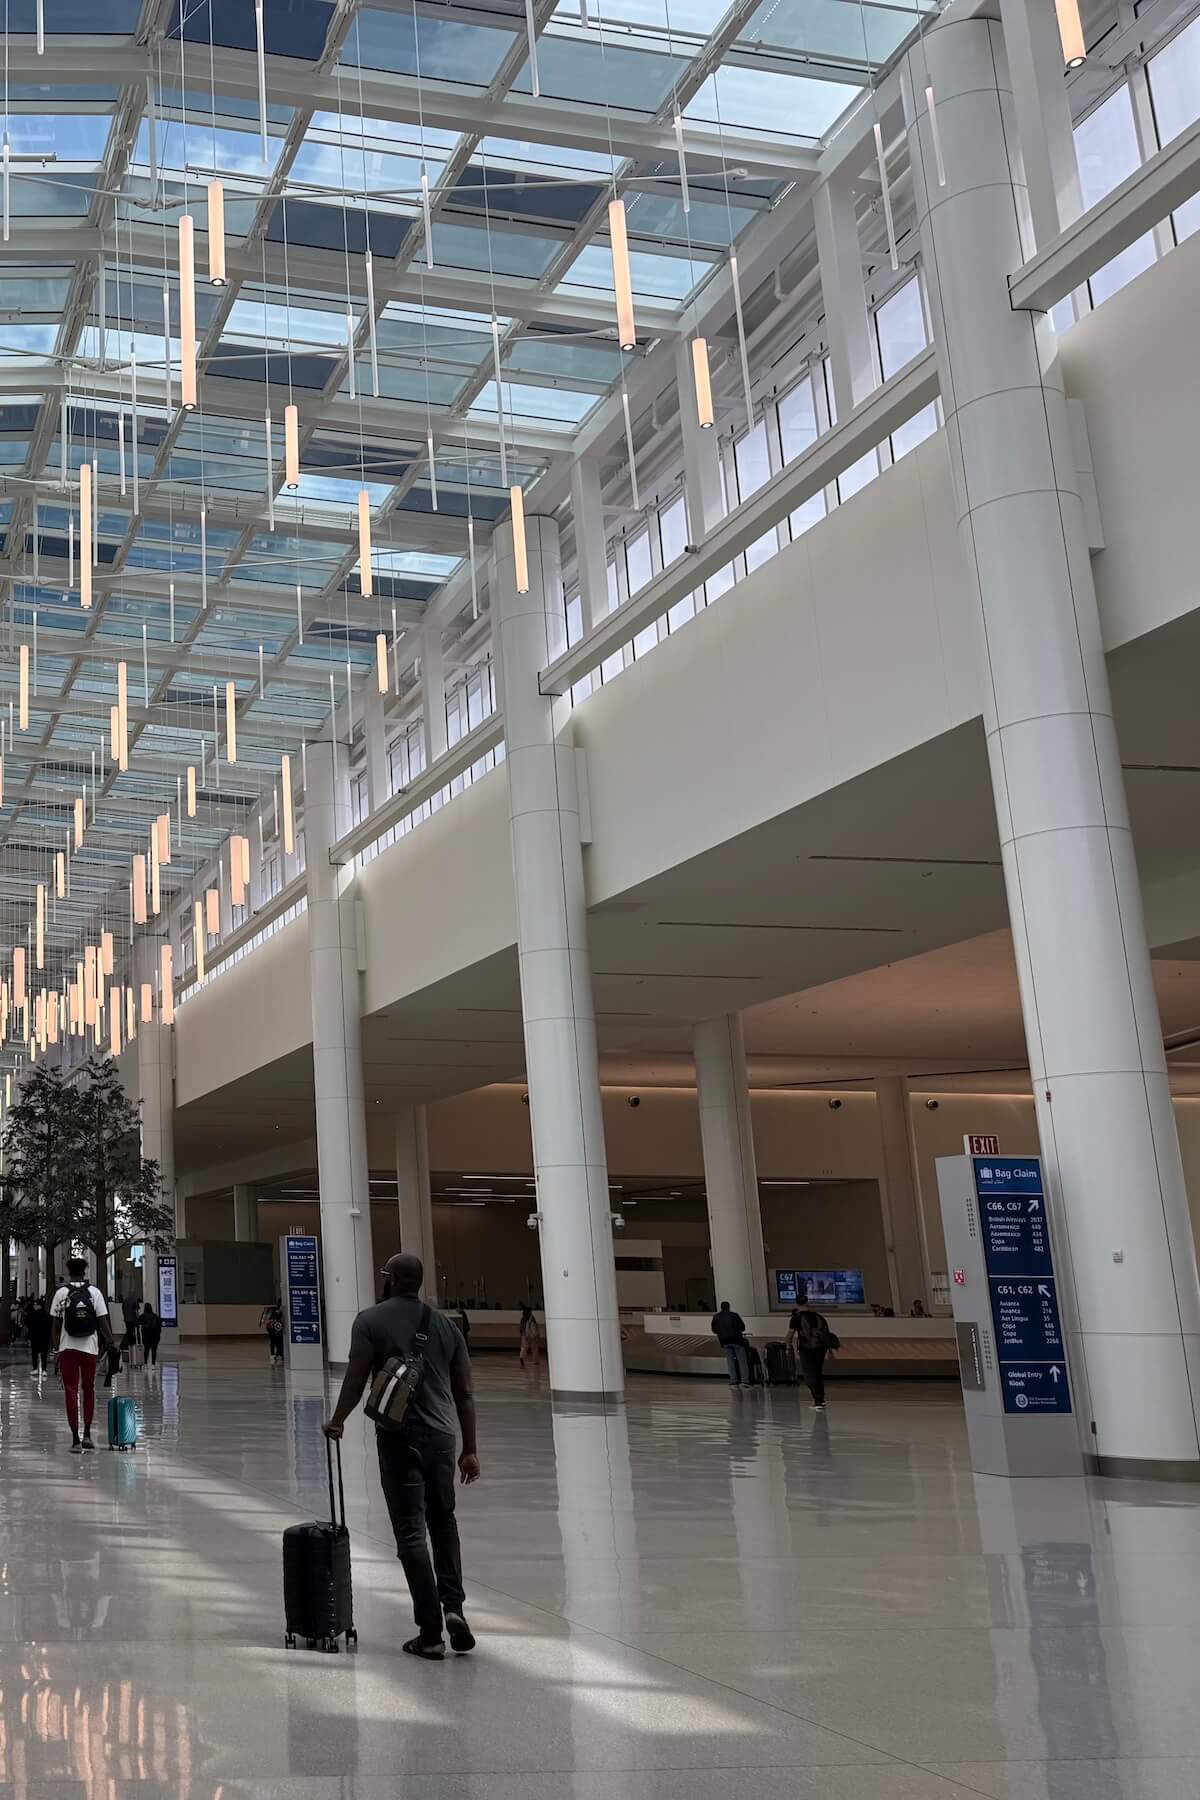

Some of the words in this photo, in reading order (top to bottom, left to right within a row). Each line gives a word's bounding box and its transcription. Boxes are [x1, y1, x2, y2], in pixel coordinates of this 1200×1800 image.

[972, 1137, 996, 1154] EXIT
[995, 1169, 1011, 1179] Bag
[1013, 1168, 1038, 1178] Claim
[986, 1202, 1005, 1211] C66,
[1007, 1202, 1021, 1211] C67
[780, 1273, 793, 1281] C67
[998, 1285, 1016, 1295] C61,
[1018, 1285, 1033, 1294] C62
[1027, 1371, 1043, 1379] Entry
